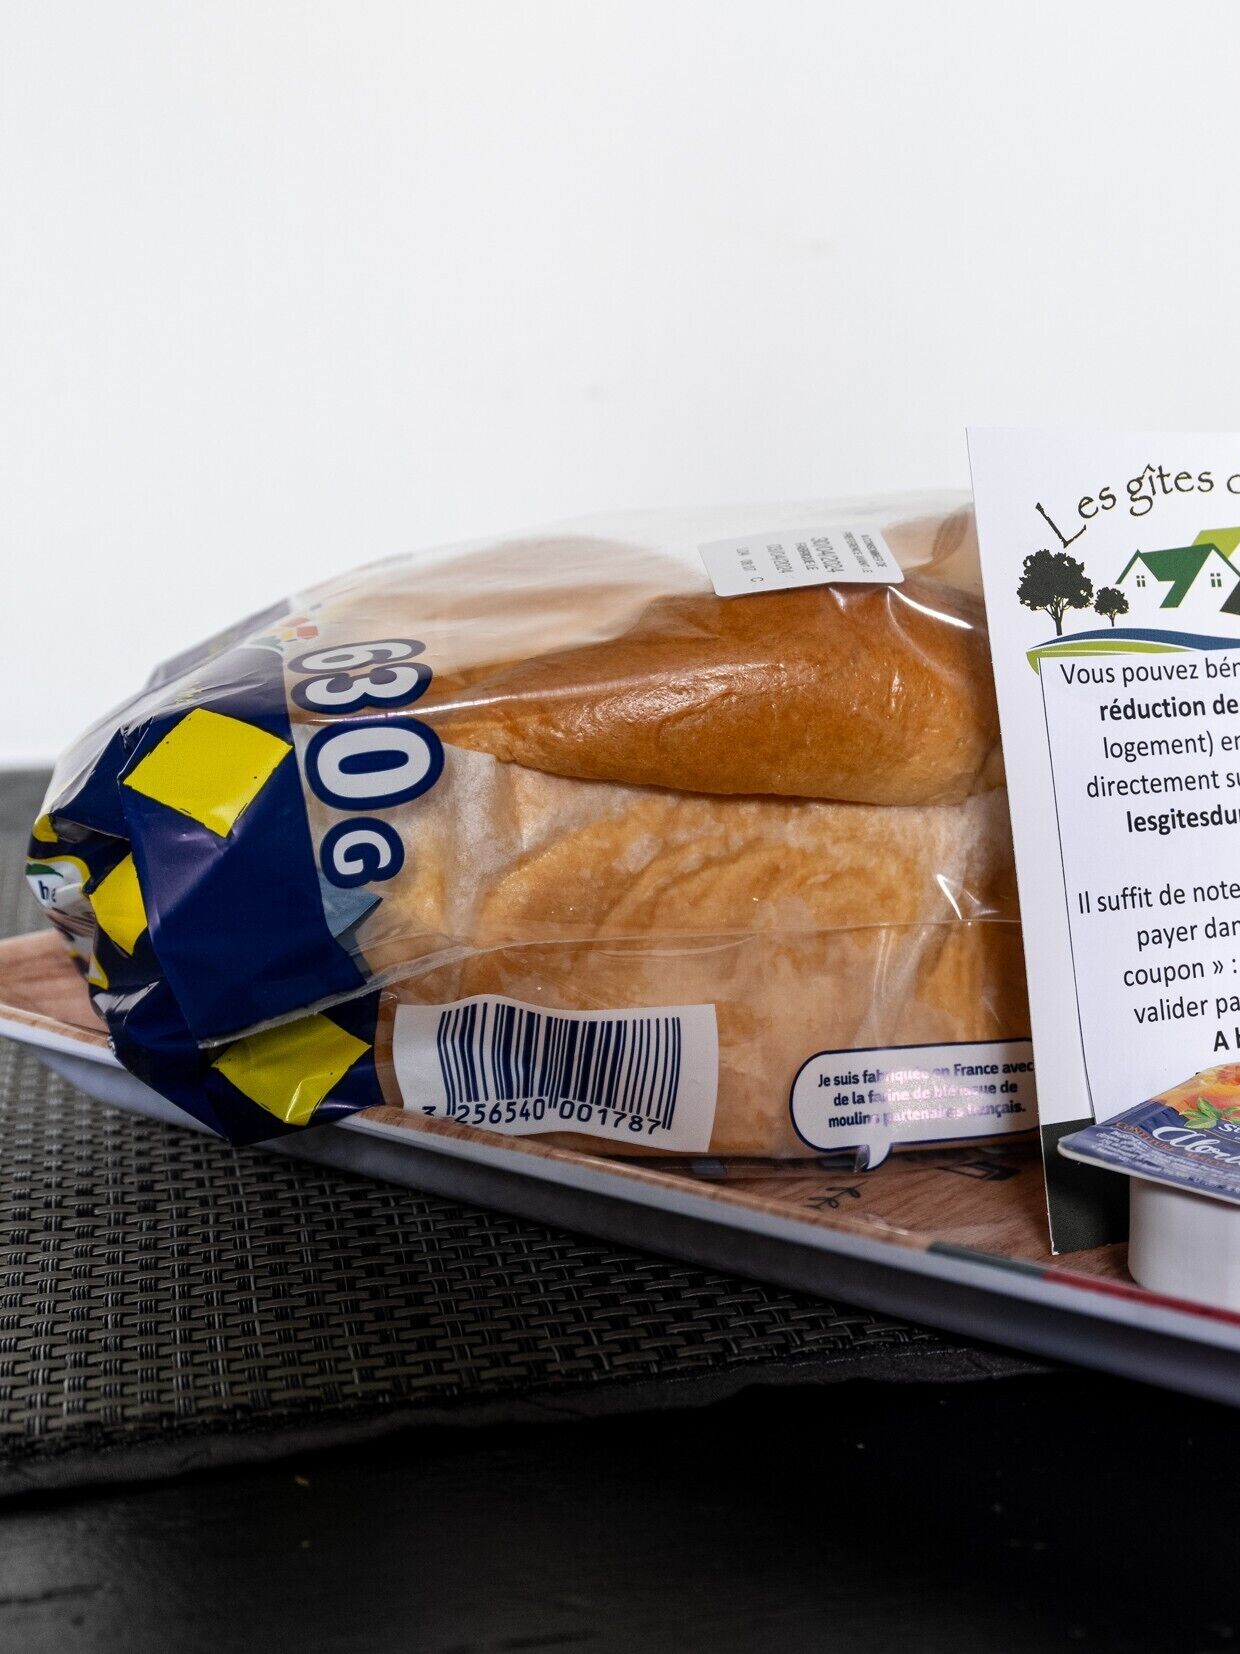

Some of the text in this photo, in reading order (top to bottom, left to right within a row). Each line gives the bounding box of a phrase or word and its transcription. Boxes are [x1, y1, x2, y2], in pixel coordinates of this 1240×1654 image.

[1034, 486, 1117, 550] Les
[1126, 463, 1215, 517] gîtes
[1059, 663, 1116, 685] Vous
[1121, 663, 1199, 688] pouvez
[1099, 695, 1206, 722] réduction
[1212, 693, 1239, 716] de
[1103, 730, 1214, 763] logement)
[1086, 770, 1221, 799] directement
[1078, 890, 1091, 915] Il
[1097, 885, 1154, 913] suffit
[1159, 882, 1186, 907] de
[1136, 924, 1198, 953] payer
[1123, 962, 1205, 988] coupon
[1133, 995, 1209, 1024] valider
[1213, 1030, 1230, 1053] A
[818, 1073, 831, 1088] Je
[833, 1069, 860, 1085] suis
[953, 1063, 999, 1077] France
[1001, 1061, 1034, 1074] avec
[833, 1092, 849, 1107] de
[851, 1090, 865, 1105] la
[912, 1085, 930, 1100] de
[1000, 1079, 1018, 1094] de
[454, 1098, 546, 1125] 256540
[559, 1099, 662, 1136] 001787
[828, 1112, 880, 1128] moulins
